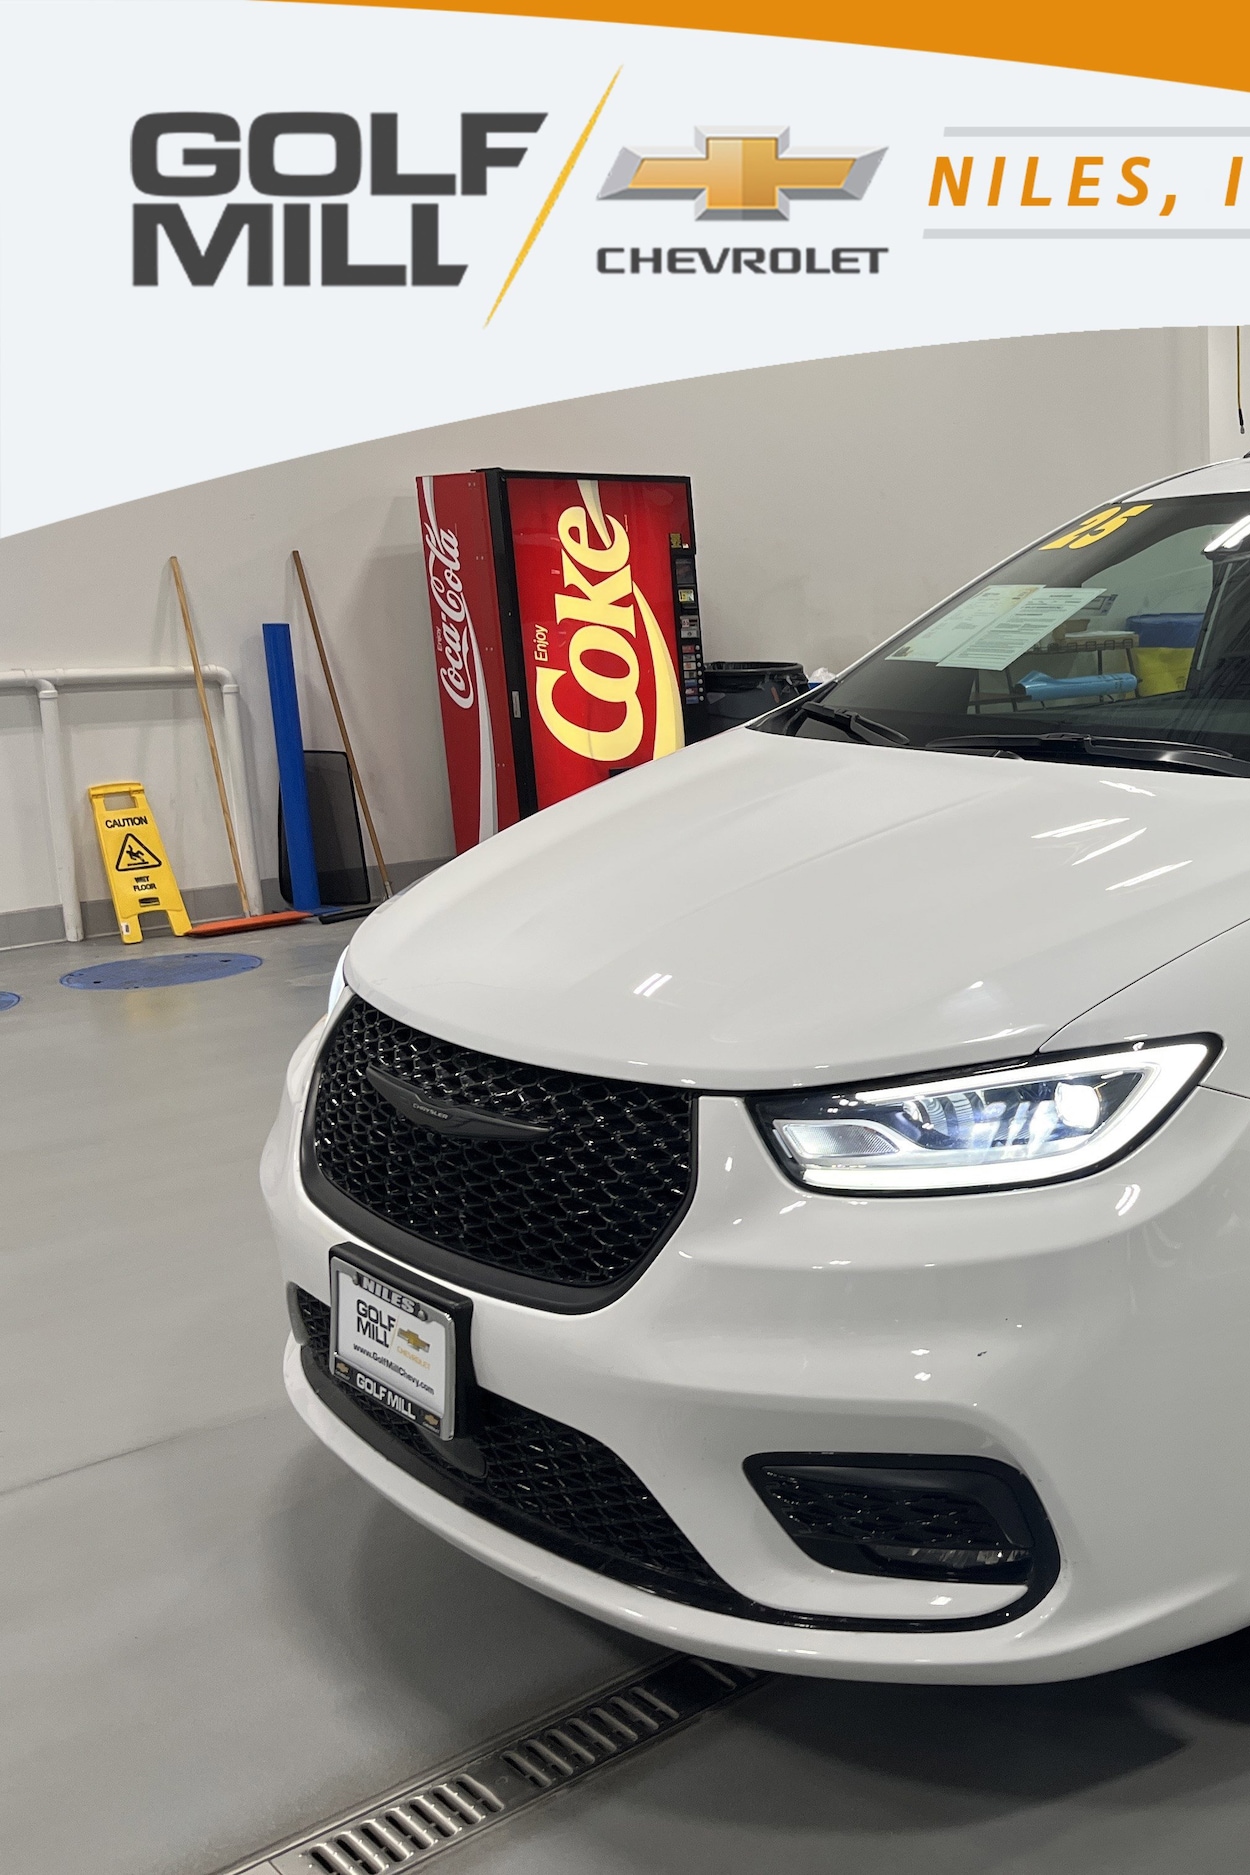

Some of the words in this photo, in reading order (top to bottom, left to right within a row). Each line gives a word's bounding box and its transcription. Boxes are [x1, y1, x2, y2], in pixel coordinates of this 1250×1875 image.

[1039, 504, 1153, 550] 25
[424, 522, 474, 709] Coca-Cola
[534, 625, 549, 662] Enjoy
[536, 505, 644, 762] Coke
[105, 815, 149, 829] CAUTION
[133, 883, 157, 892] FLOOR
[412, 1103, 449, 1120] CHRYSLER
[361, 1273, 416, 1314] NILES
[356, 1299, 397, 1332] GOLF
[356, 1316, 389, 1349] MILL
[353, 1342, 435, 1395] www.GolfMillChevy.com
[356, 1372, 388, 1401] GOLF
[387, 1391, 416, 1420] MILL
